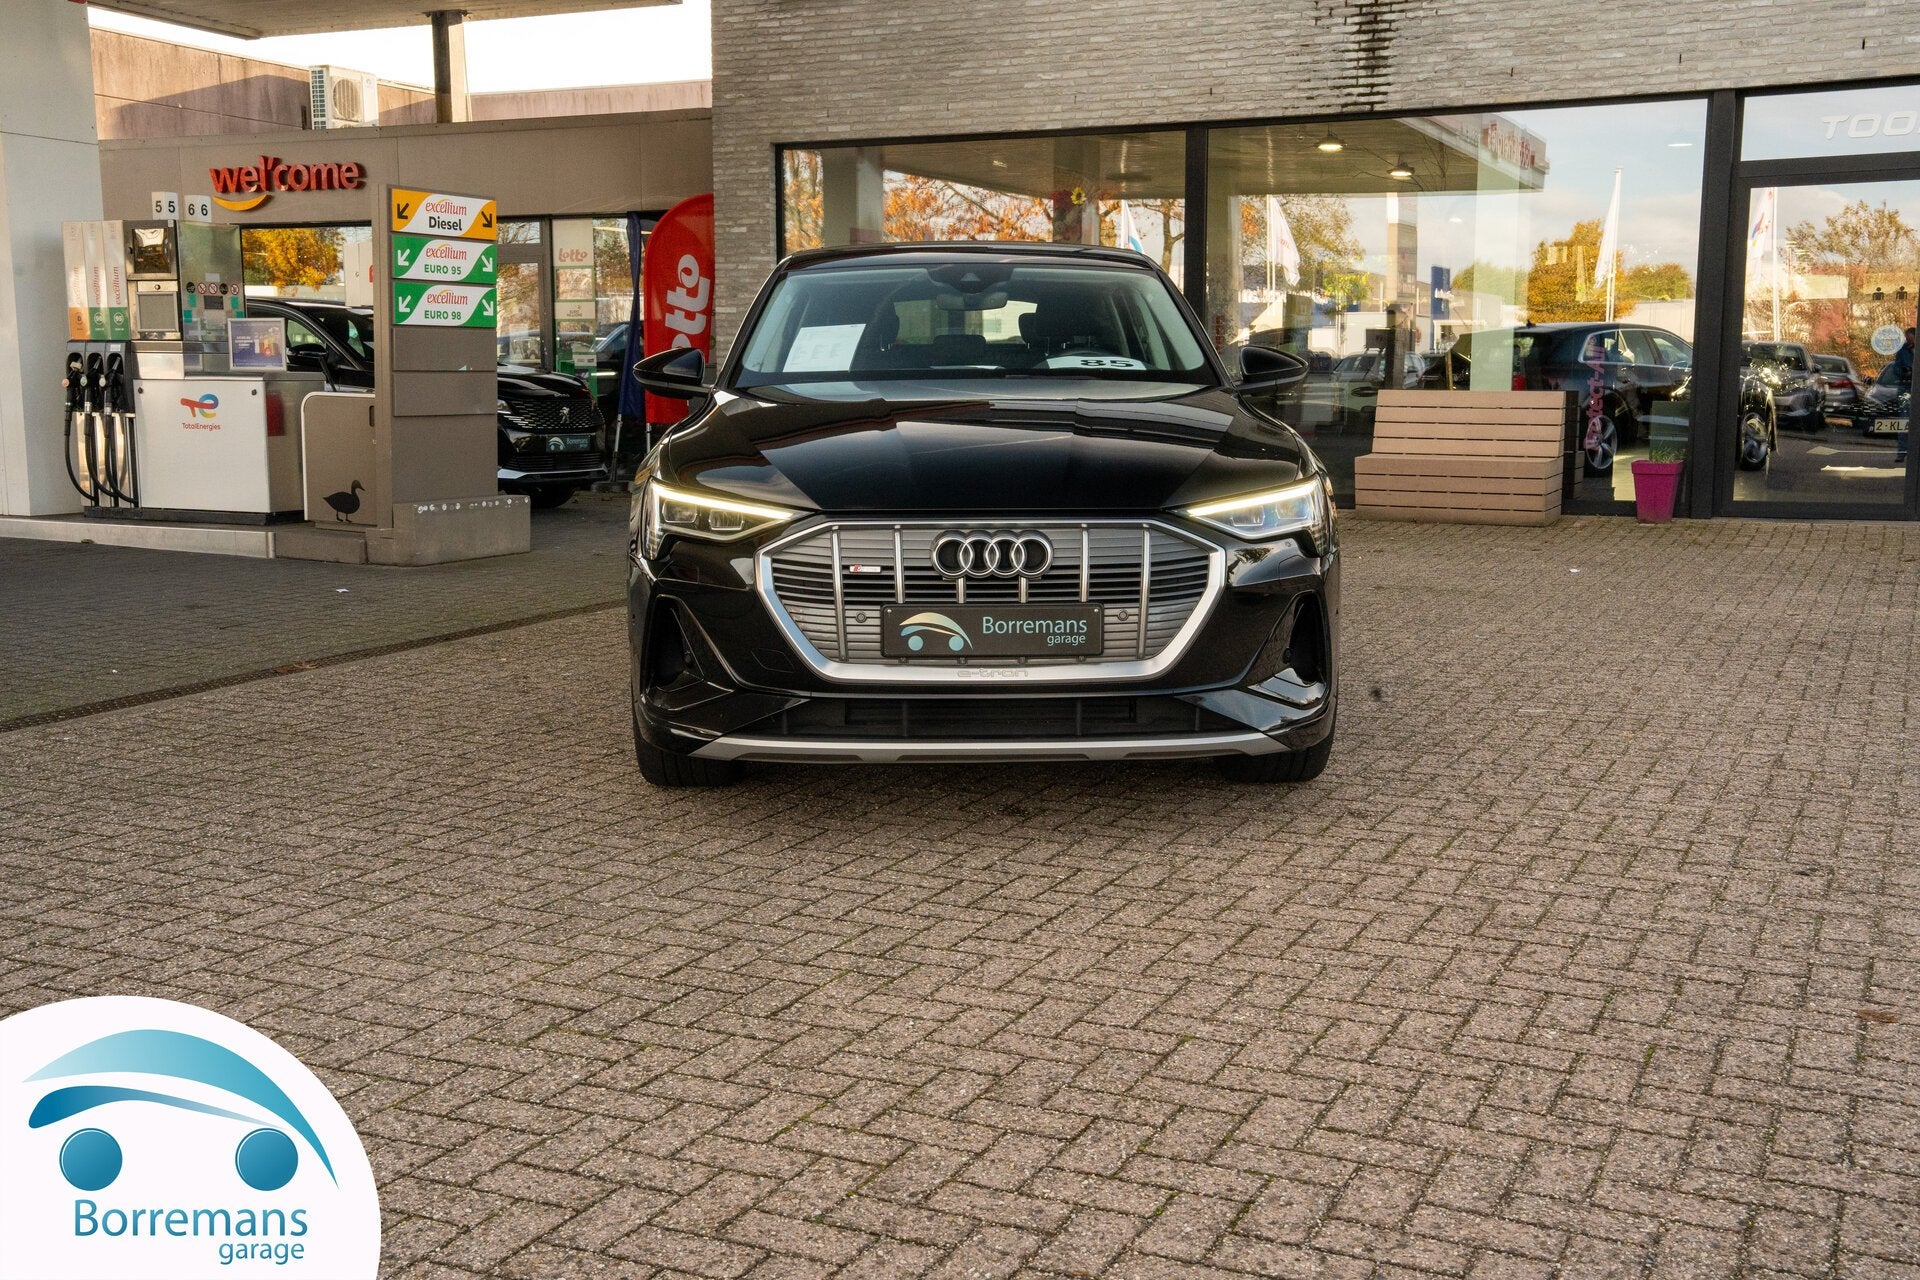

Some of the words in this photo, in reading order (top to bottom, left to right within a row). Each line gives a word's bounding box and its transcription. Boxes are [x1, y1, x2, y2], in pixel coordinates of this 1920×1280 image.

[1821, 111, 1920, 140] TOO
[155, 200, 162, 213] 5
[168, 200, 176, 213] 5
[188, 203, 195, 216] 6
[201, 204, 208, 216] 6
[425, 199, 467, 216] excellium
[428, 216, 462, 231] Diesel
[425, 244, 467, 260] excellium
[424, 264, 449, 275] EURO
[451, 265, 462, 275] 95
[426, 290, 468, 305] excellium
[424, 310, 449, 321] EURO
[451, 311, 462, 321] 98
[181, 423, 221, 431] TotalEnergies
[982, 616, 1088, 635] Borremans
[1047, 634, 1086, 646] garage
